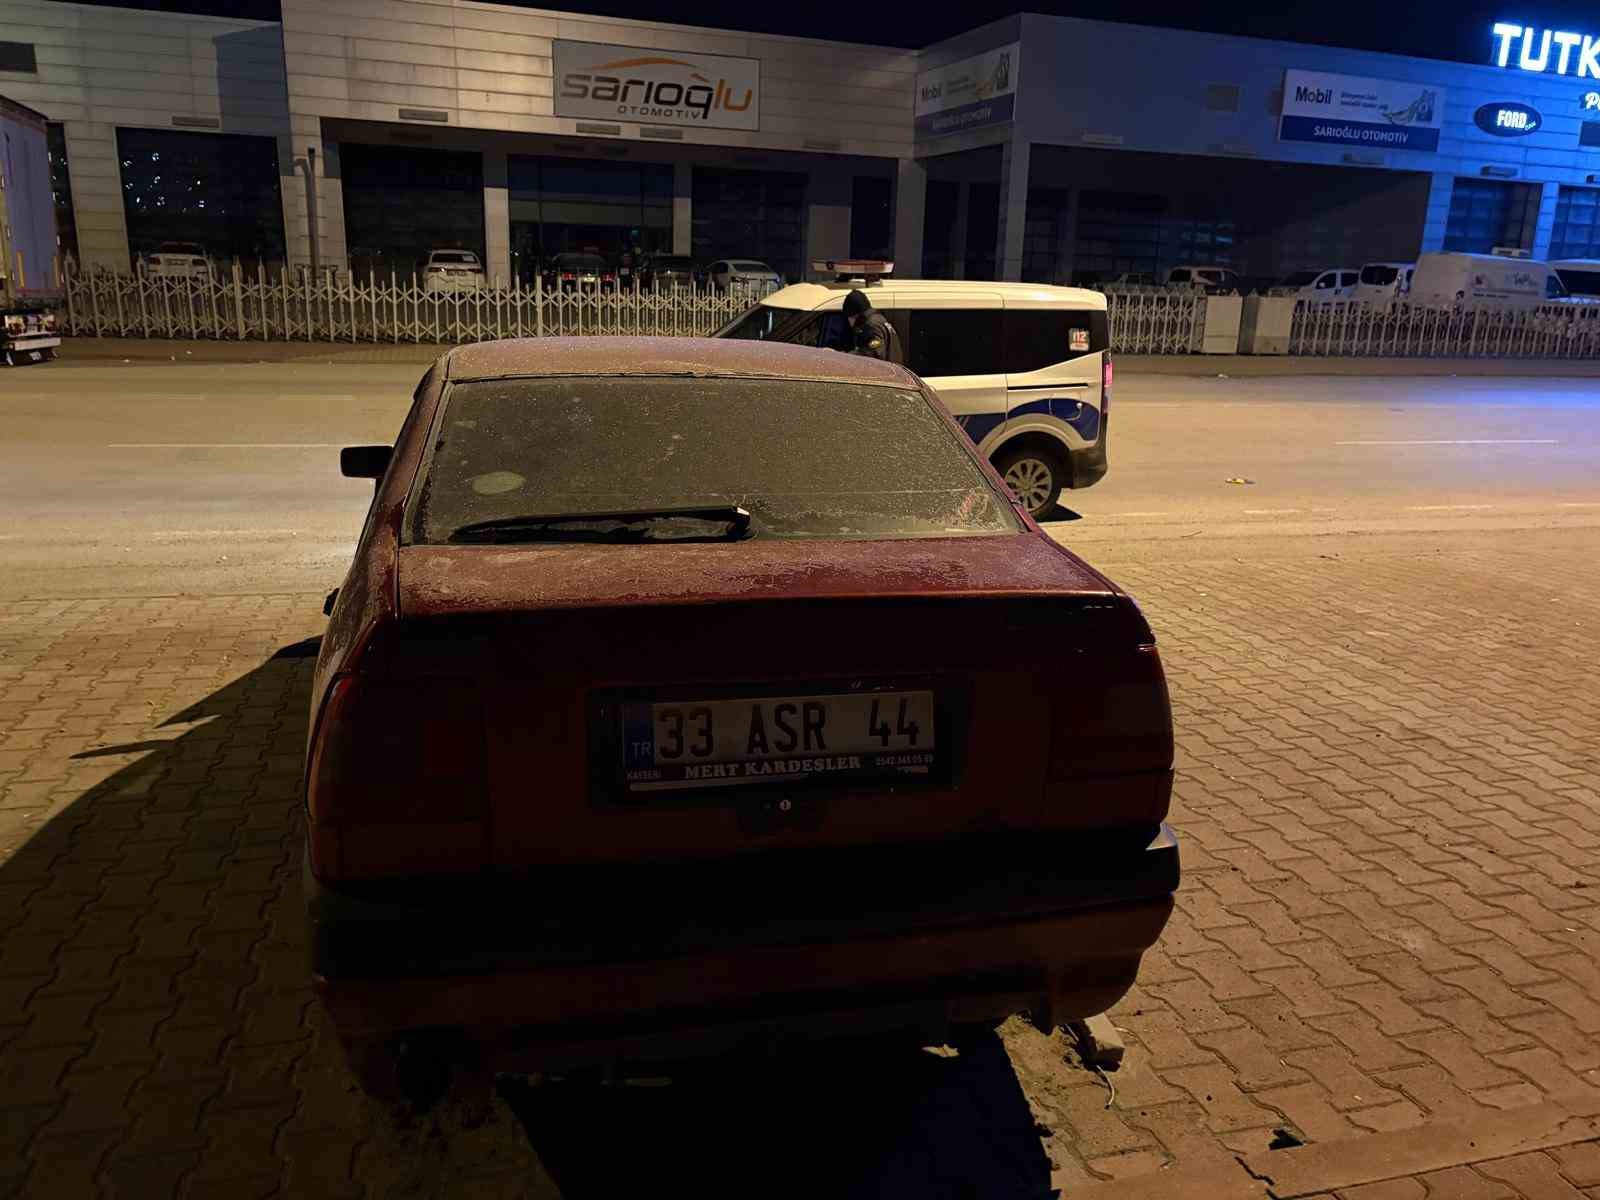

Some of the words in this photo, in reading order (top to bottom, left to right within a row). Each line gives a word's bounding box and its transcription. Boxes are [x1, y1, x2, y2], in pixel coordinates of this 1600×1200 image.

[1296, 86, 1333, 105] Mobil
[1496, 109, 1528, 129] FORD
[659, 707, 713, 759] 33
[748, 702, 826, 756] ASR
[869, 696, 919, 747] 44
[631, 742, 653, 759] TR
[685, 762, 739, 778] MERT
